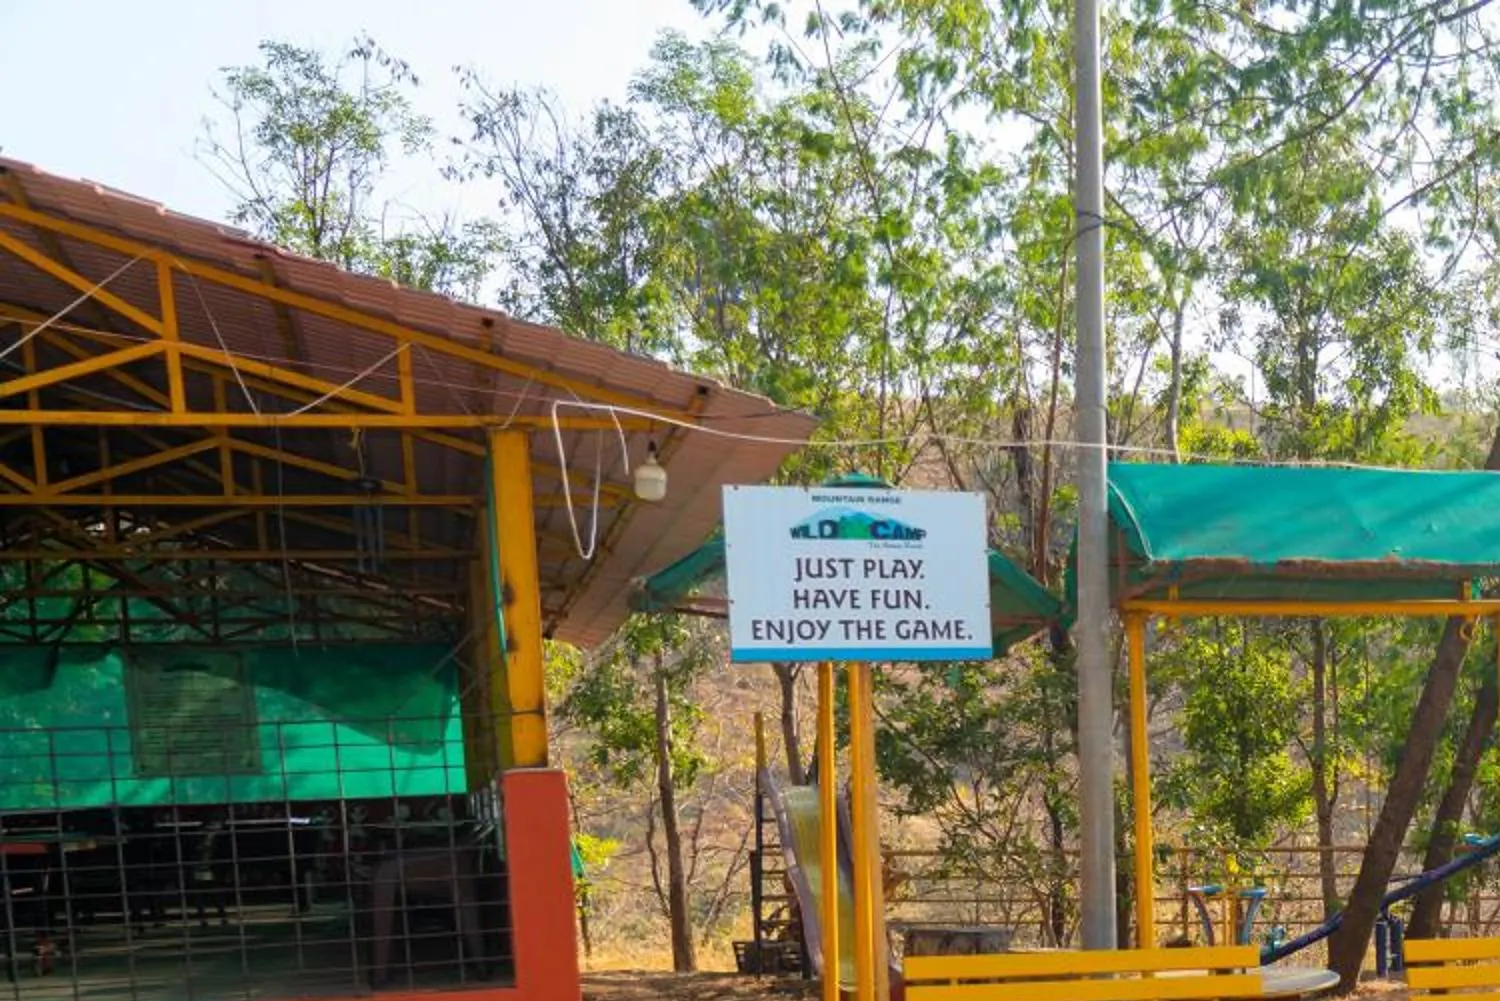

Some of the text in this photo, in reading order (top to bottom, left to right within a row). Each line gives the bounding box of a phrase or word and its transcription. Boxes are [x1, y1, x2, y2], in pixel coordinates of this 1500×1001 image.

[811, 495, 865, 503] MOUNTAIN
[790, 519, 927, 540] WILD CAMP
[794, 558, 925, 581] JUST PLAY.
[793, 589, 930, 610] HAVE FUN.
[752, 620, 973, 644] ENJOY THE GAME.
